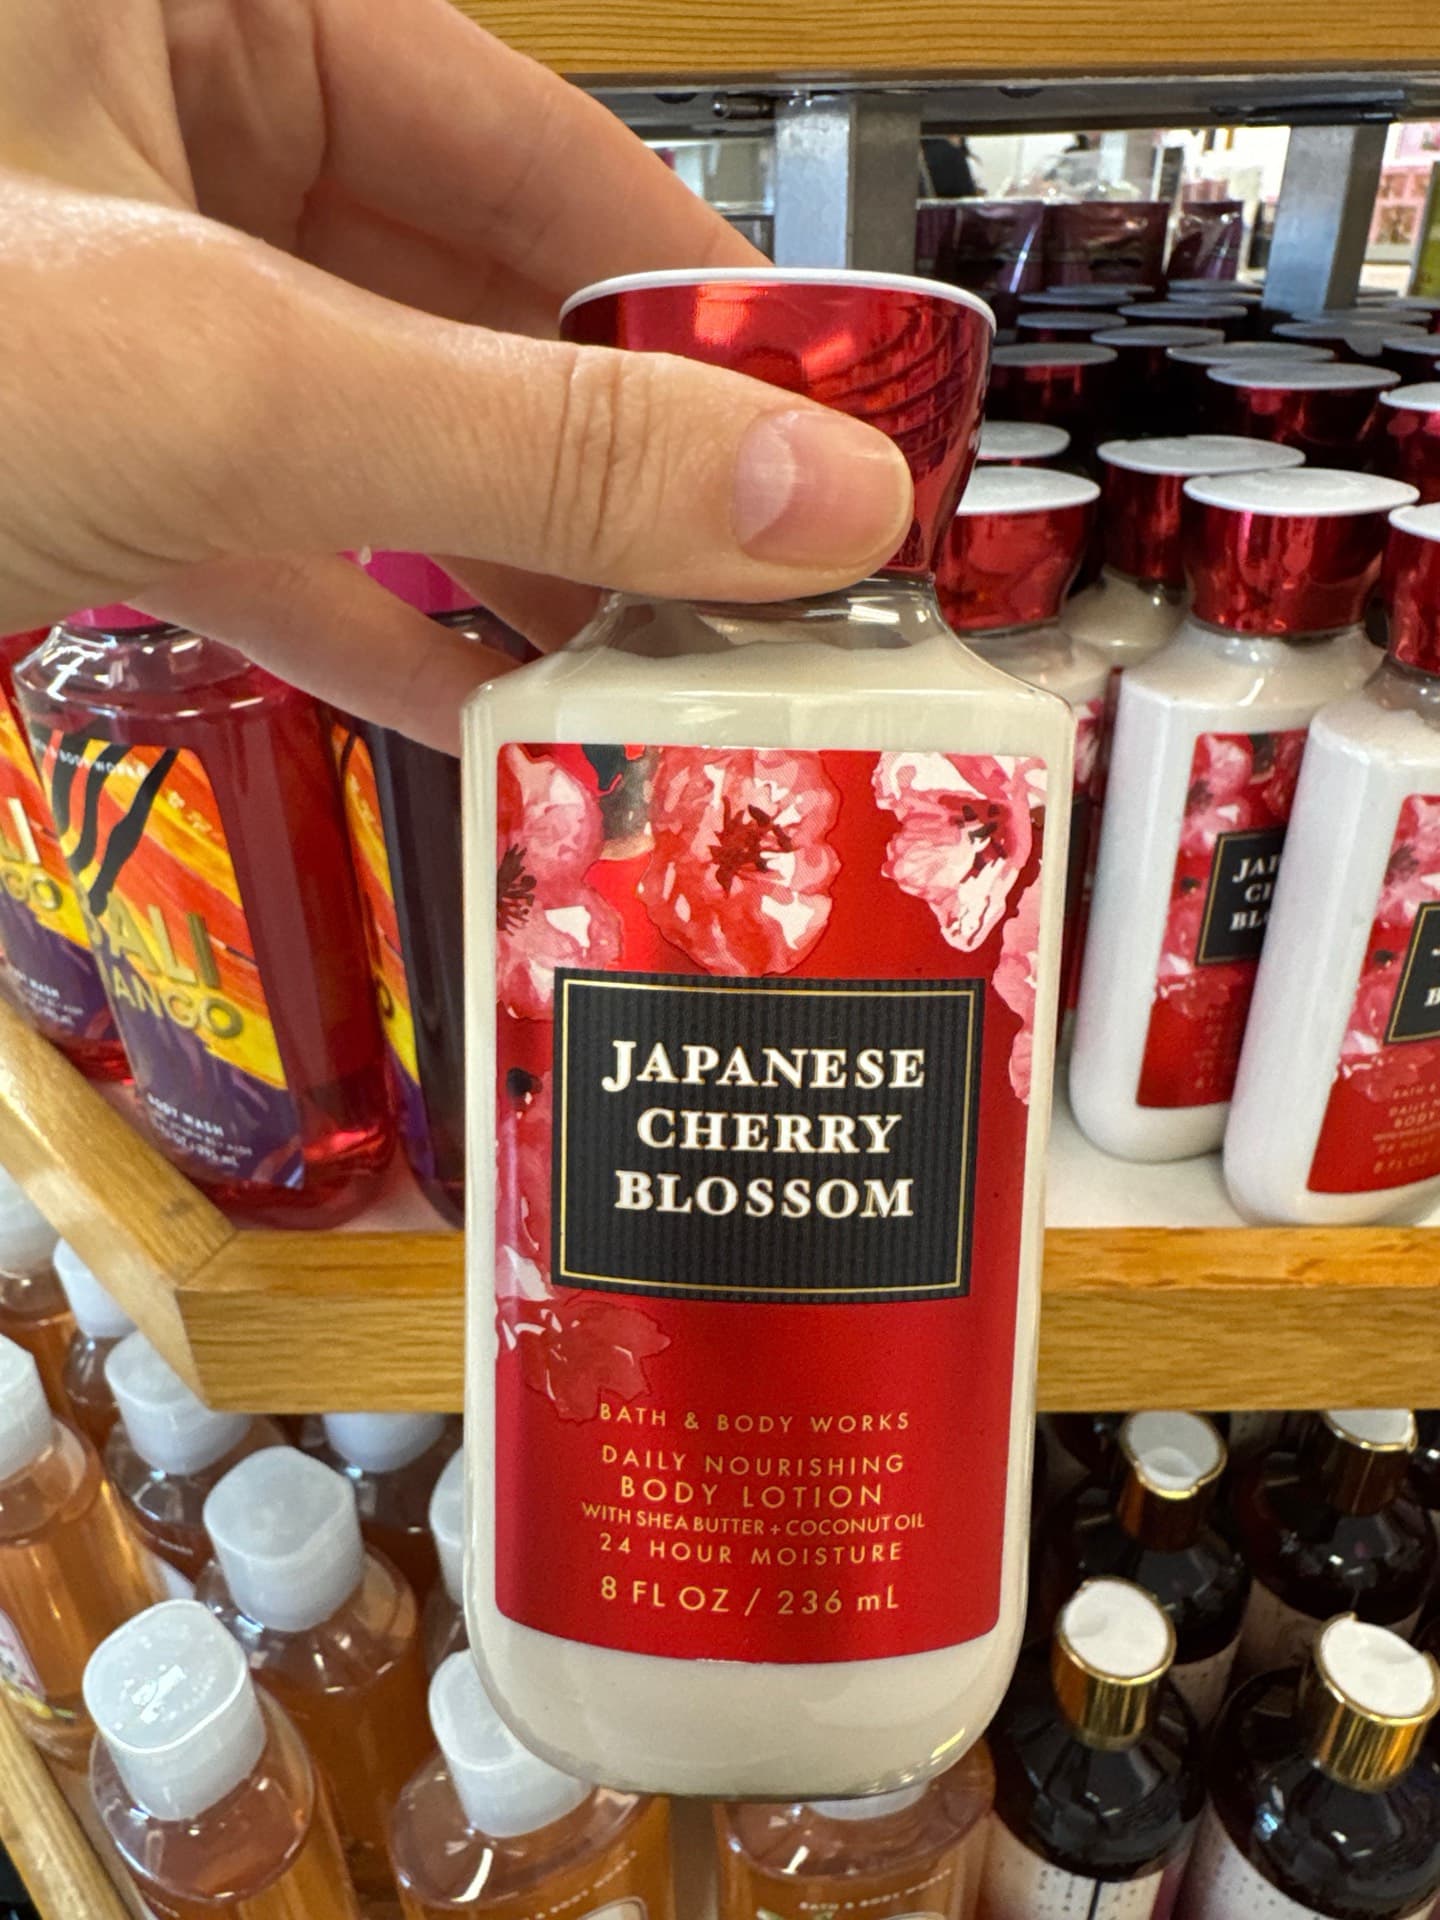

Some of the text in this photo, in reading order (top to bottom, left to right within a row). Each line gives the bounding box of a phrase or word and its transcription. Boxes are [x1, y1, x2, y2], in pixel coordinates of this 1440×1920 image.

[88, 892, 220, 989] ALI
[108, 964, 244, 1039] ANGO
[601, 1040, 926, 1092] JAPANESE
[637, 1107, 902, 1154] CHERRY
[614, 1169, 915, 1219] BLOSSOM
[599, 1402, 909, 1433] BATH & BODY WORKS
[602, 1444, 904, 1477] DAILY NOURISHING
[620, 1475, 882, 1509] BODY LOTION
[581, 1501, 926, 1537] WITH SHEA BUTTER + COCONUT OIL
[599, 1532, 903, 1566] 24 HOUR MOISTURE
[601, 1576, 899, 1616] 8 FL OZ / 236 mL
